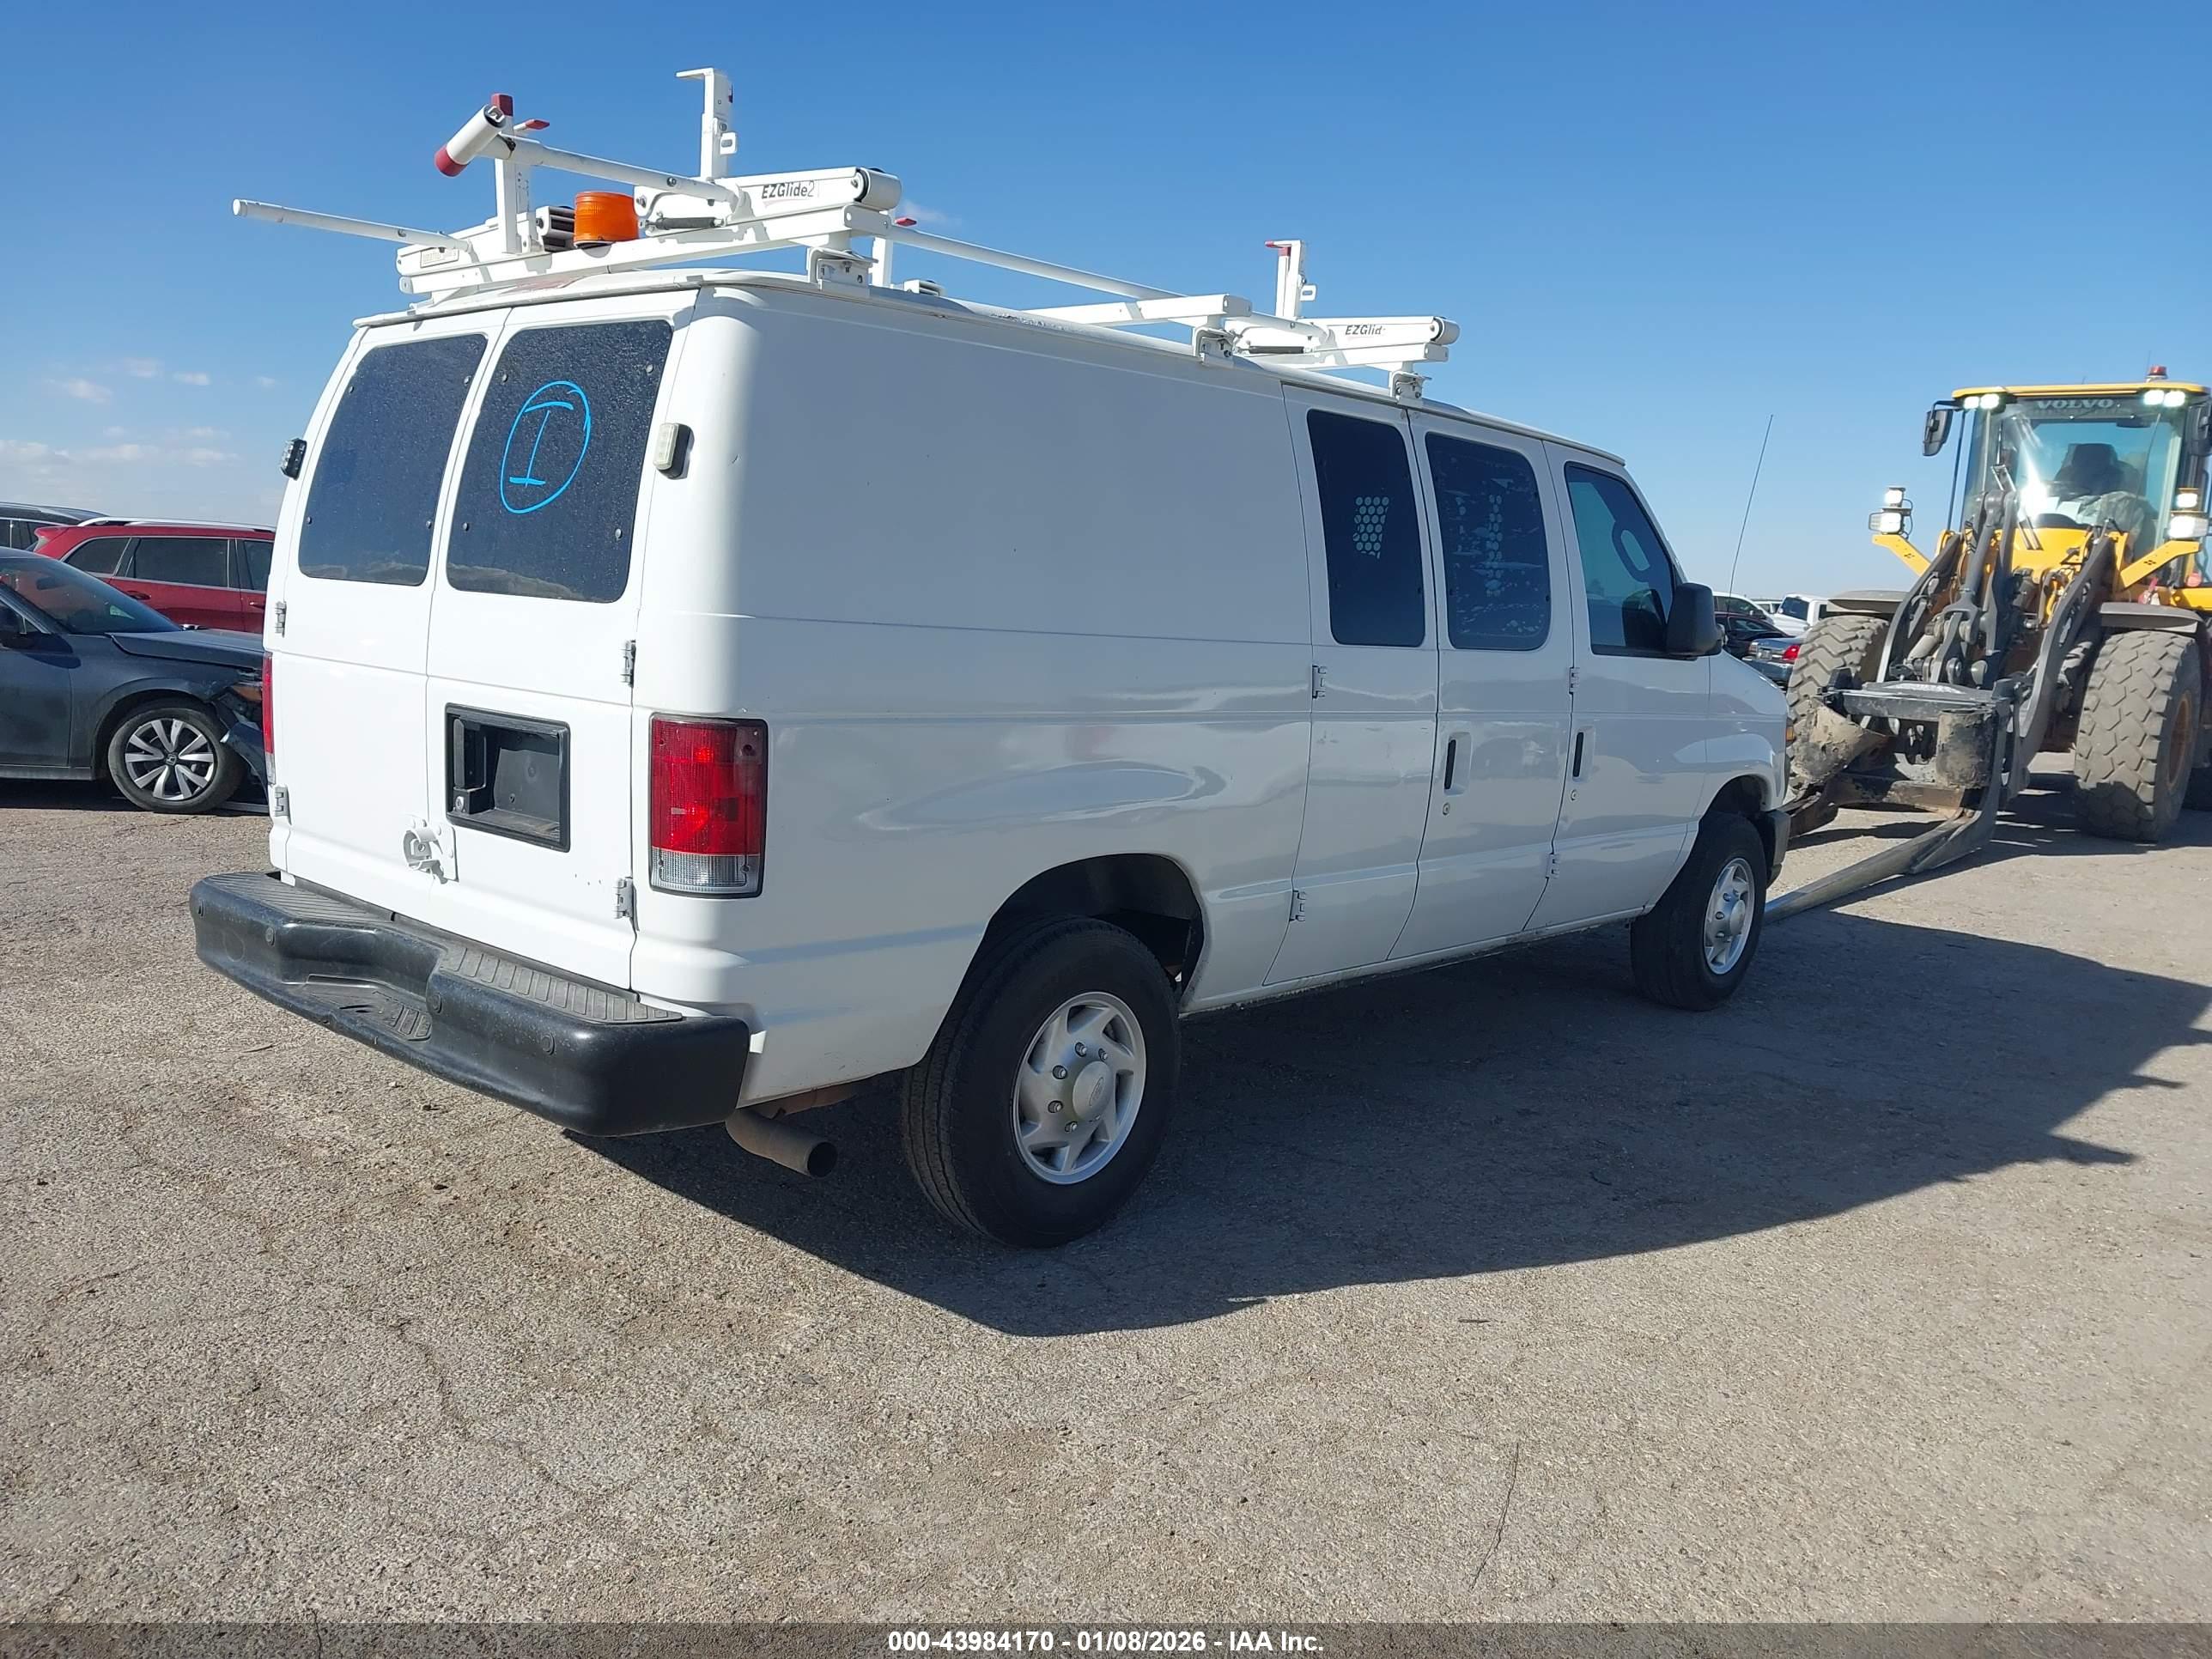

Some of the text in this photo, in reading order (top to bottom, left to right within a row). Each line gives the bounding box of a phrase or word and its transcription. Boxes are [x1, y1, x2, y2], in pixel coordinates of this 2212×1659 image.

[762, 179, 815, 199] EZGlide2
[1345, 324, 1386, 337] EZGlid
[2036, 398, 2114, 410] VOLVO
